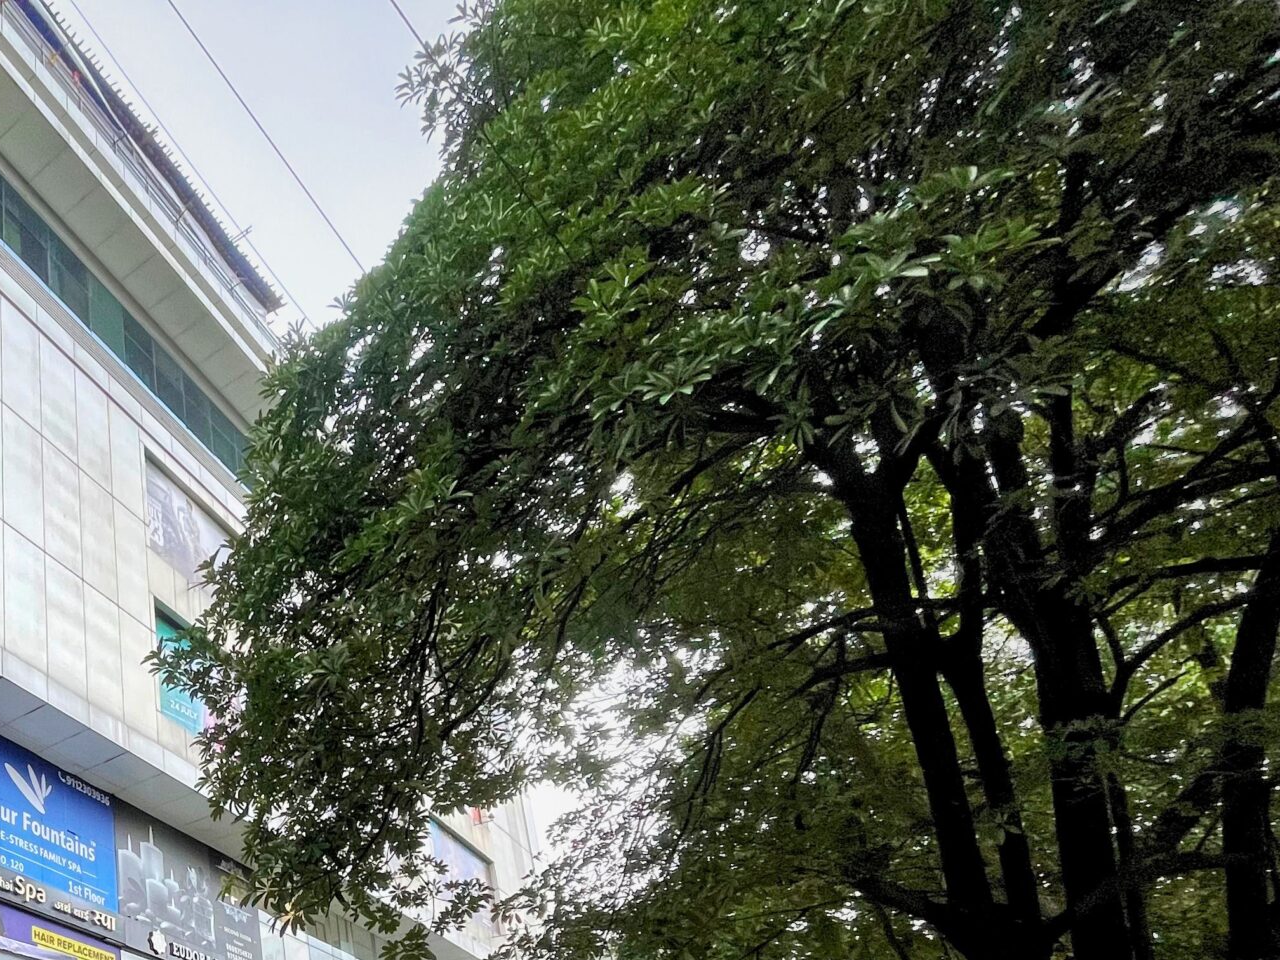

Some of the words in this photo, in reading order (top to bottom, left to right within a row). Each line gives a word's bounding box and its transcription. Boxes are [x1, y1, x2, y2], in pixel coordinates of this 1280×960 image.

[170, 699, 180, 711] 24
[181, 705, 198, 720] JULY
[22, 811, 96, 862] Fountains
[10, 858, 25, 873] 120
[39, 846, 67, 868] FAMILY
[67, 858, 82, 875] SPA
[14, 875, 46, 903] Spa
[68, 880, 82, 897] 1st
[84, 886, 106, 906] Floor
[33, 929, 55, 946] HAIR
